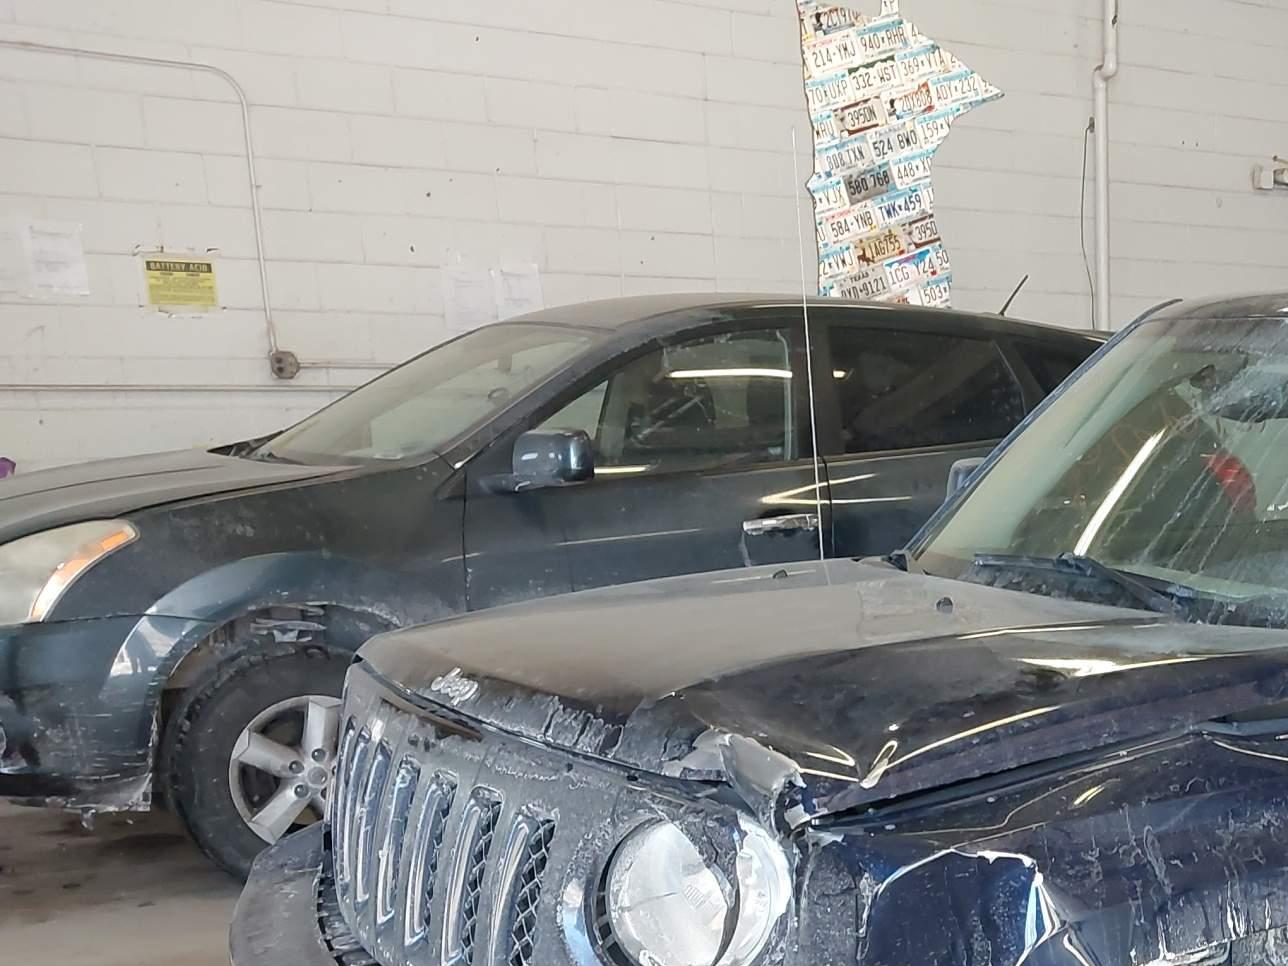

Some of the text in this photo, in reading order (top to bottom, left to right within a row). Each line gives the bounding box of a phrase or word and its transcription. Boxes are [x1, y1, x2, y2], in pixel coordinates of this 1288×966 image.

[872, 138, 894, 157] 524
[847, 170, 890, 196] 580 768
[150, 262, 208, 272] BATTERY ACID
[850, 271, 870, 283] TEXAS
